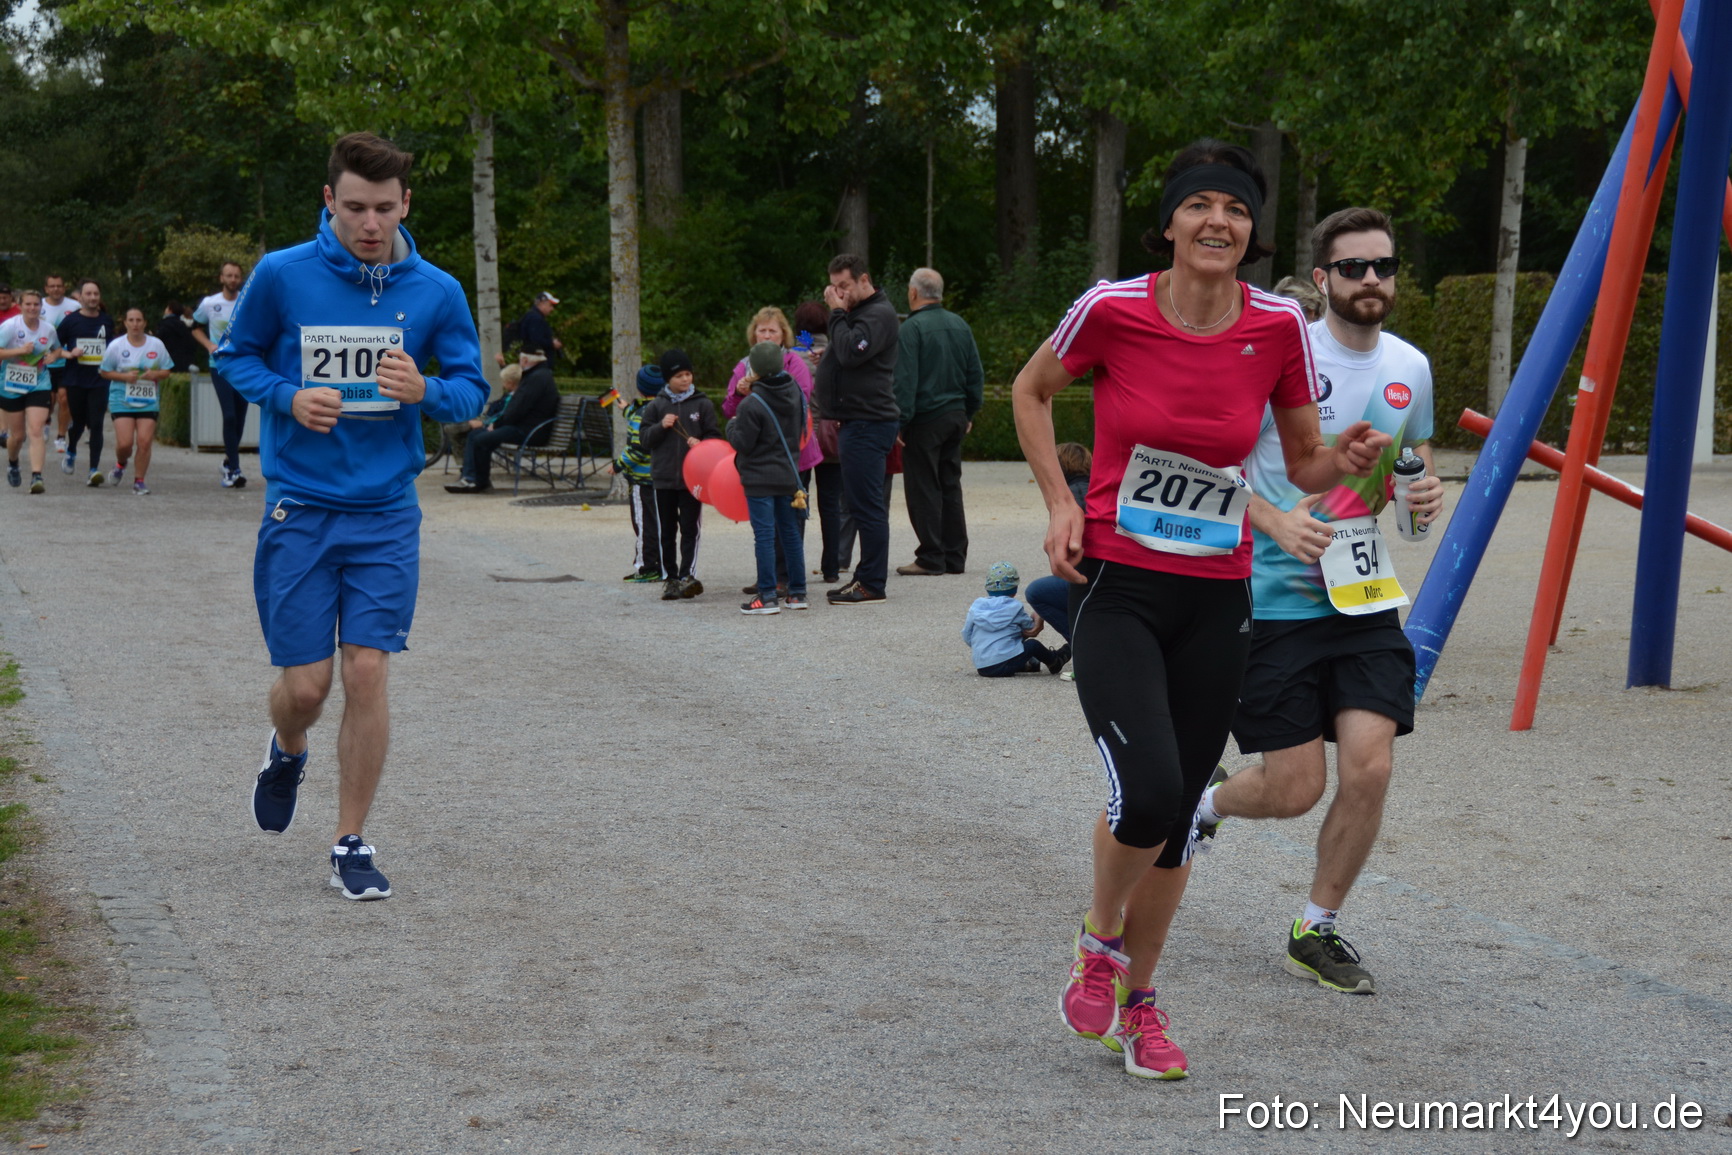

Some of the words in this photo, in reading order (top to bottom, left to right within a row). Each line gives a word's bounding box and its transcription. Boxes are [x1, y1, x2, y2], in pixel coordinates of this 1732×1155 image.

[304, 335, 337, 343] PARTL
[340, 335, 386, 343] Neumarkt
[83, 345, 101, 355] 276
[9, 371, 35, 384] 2262
[129, 385, 154, 397] 2286
[331, 386, 373, 399] obias
[1318, 406, 1335, 414] RTL
[1134, 453, 1175, 468] PARTL
[1132, 469, 1237, 516] 2071
[1153, 518, 1202, 540] Agnes
[1331, 530, 1351, 540] RTL
[1351, 540, 1379, 576] 54
[1364, 585, 1384, 600] Marc
